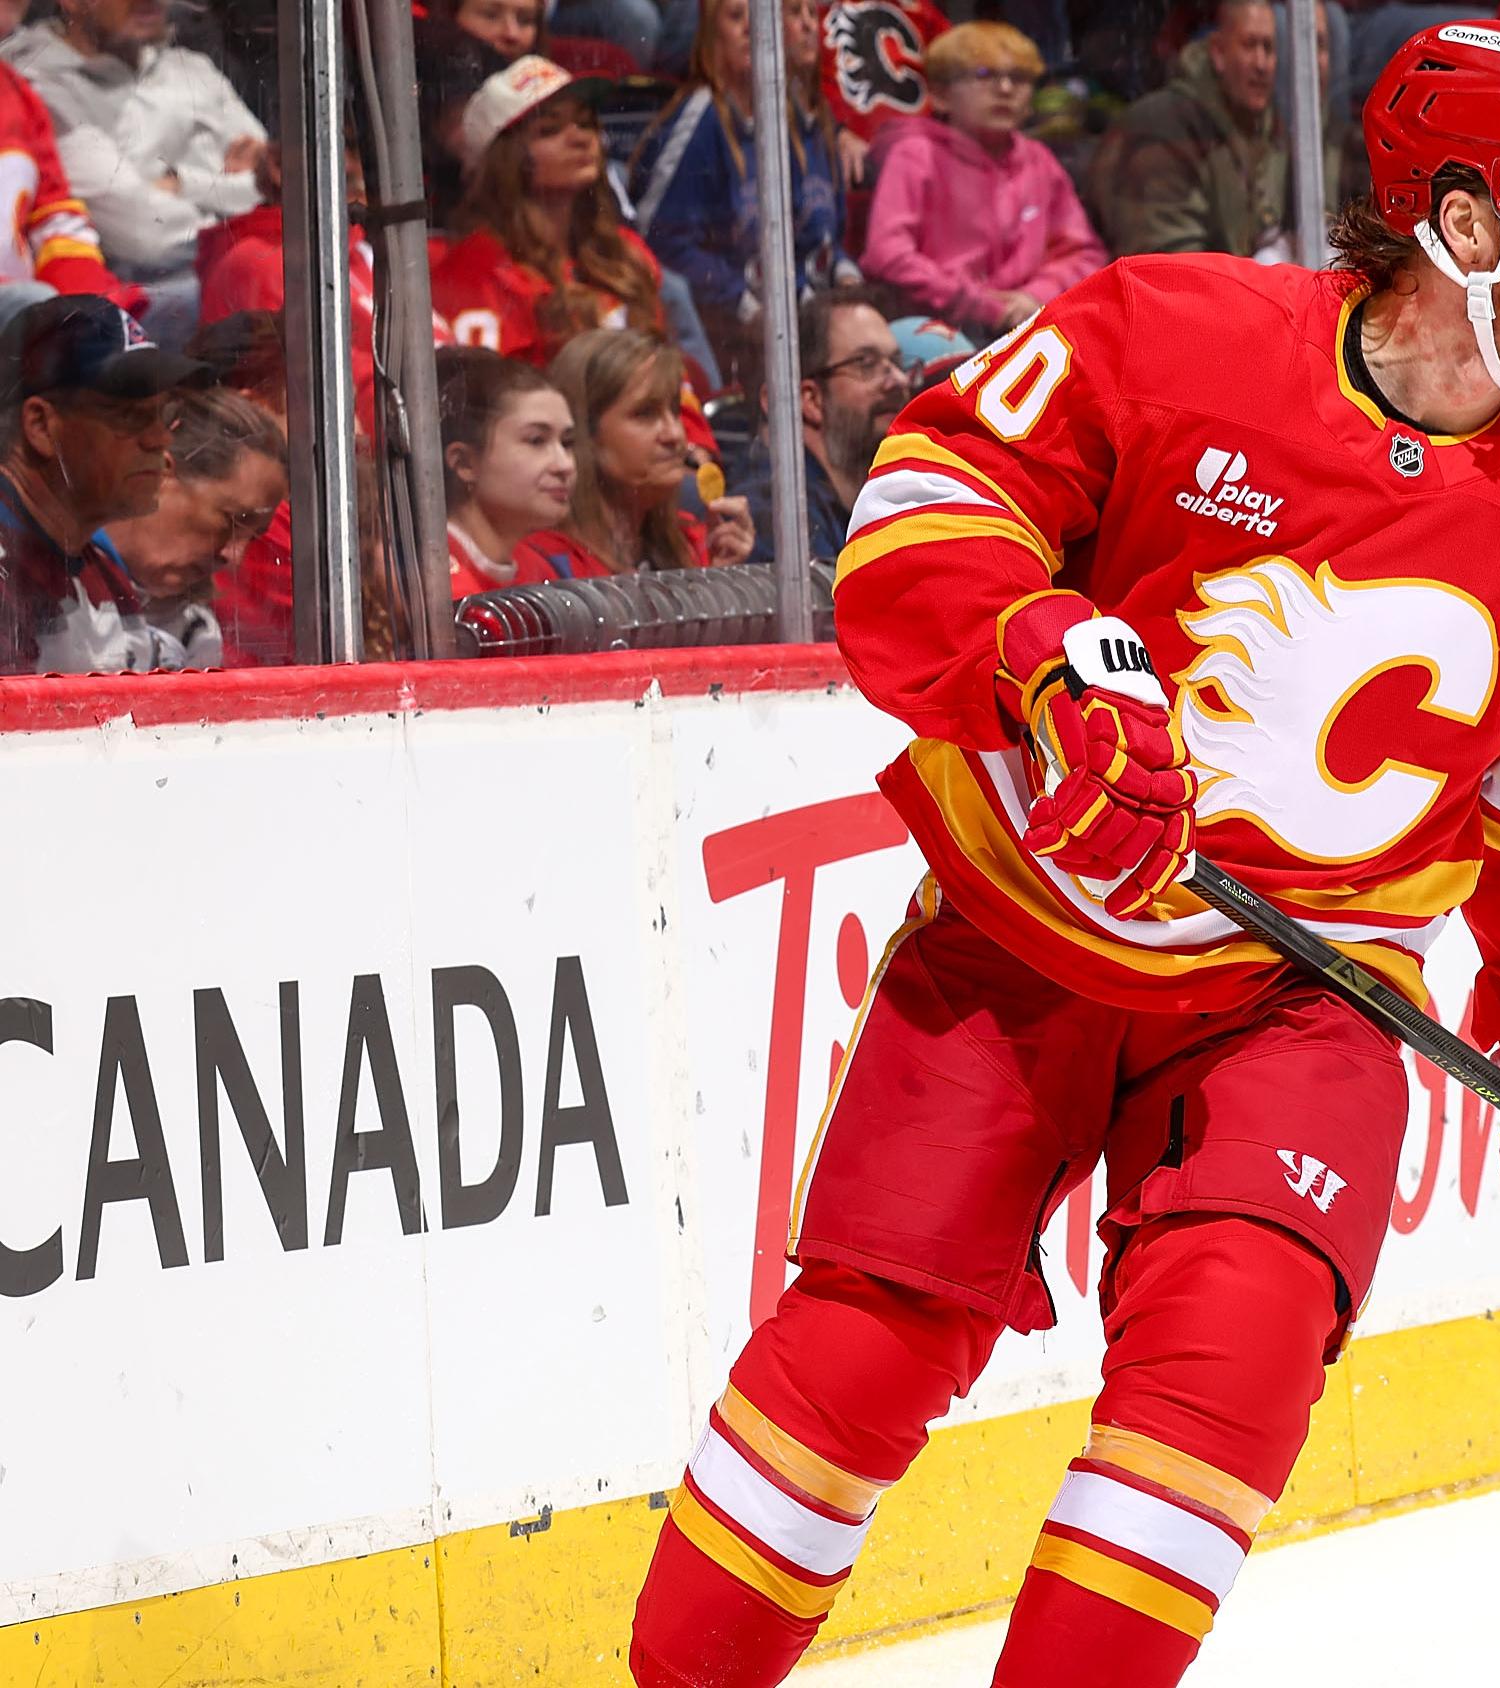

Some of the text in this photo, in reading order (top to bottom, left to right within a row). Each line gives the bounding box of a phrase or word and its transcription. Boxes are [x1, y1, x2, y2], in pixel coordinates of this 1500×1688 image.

[1396, 449, 1418, 466] NHL
[1175, 491, 1278, 538] alberta
[1215, 483, 1285, 518] play
[1427, 1054, 1477, 1088] ALPHA
[0, 955, 629, 1298] CANADA
